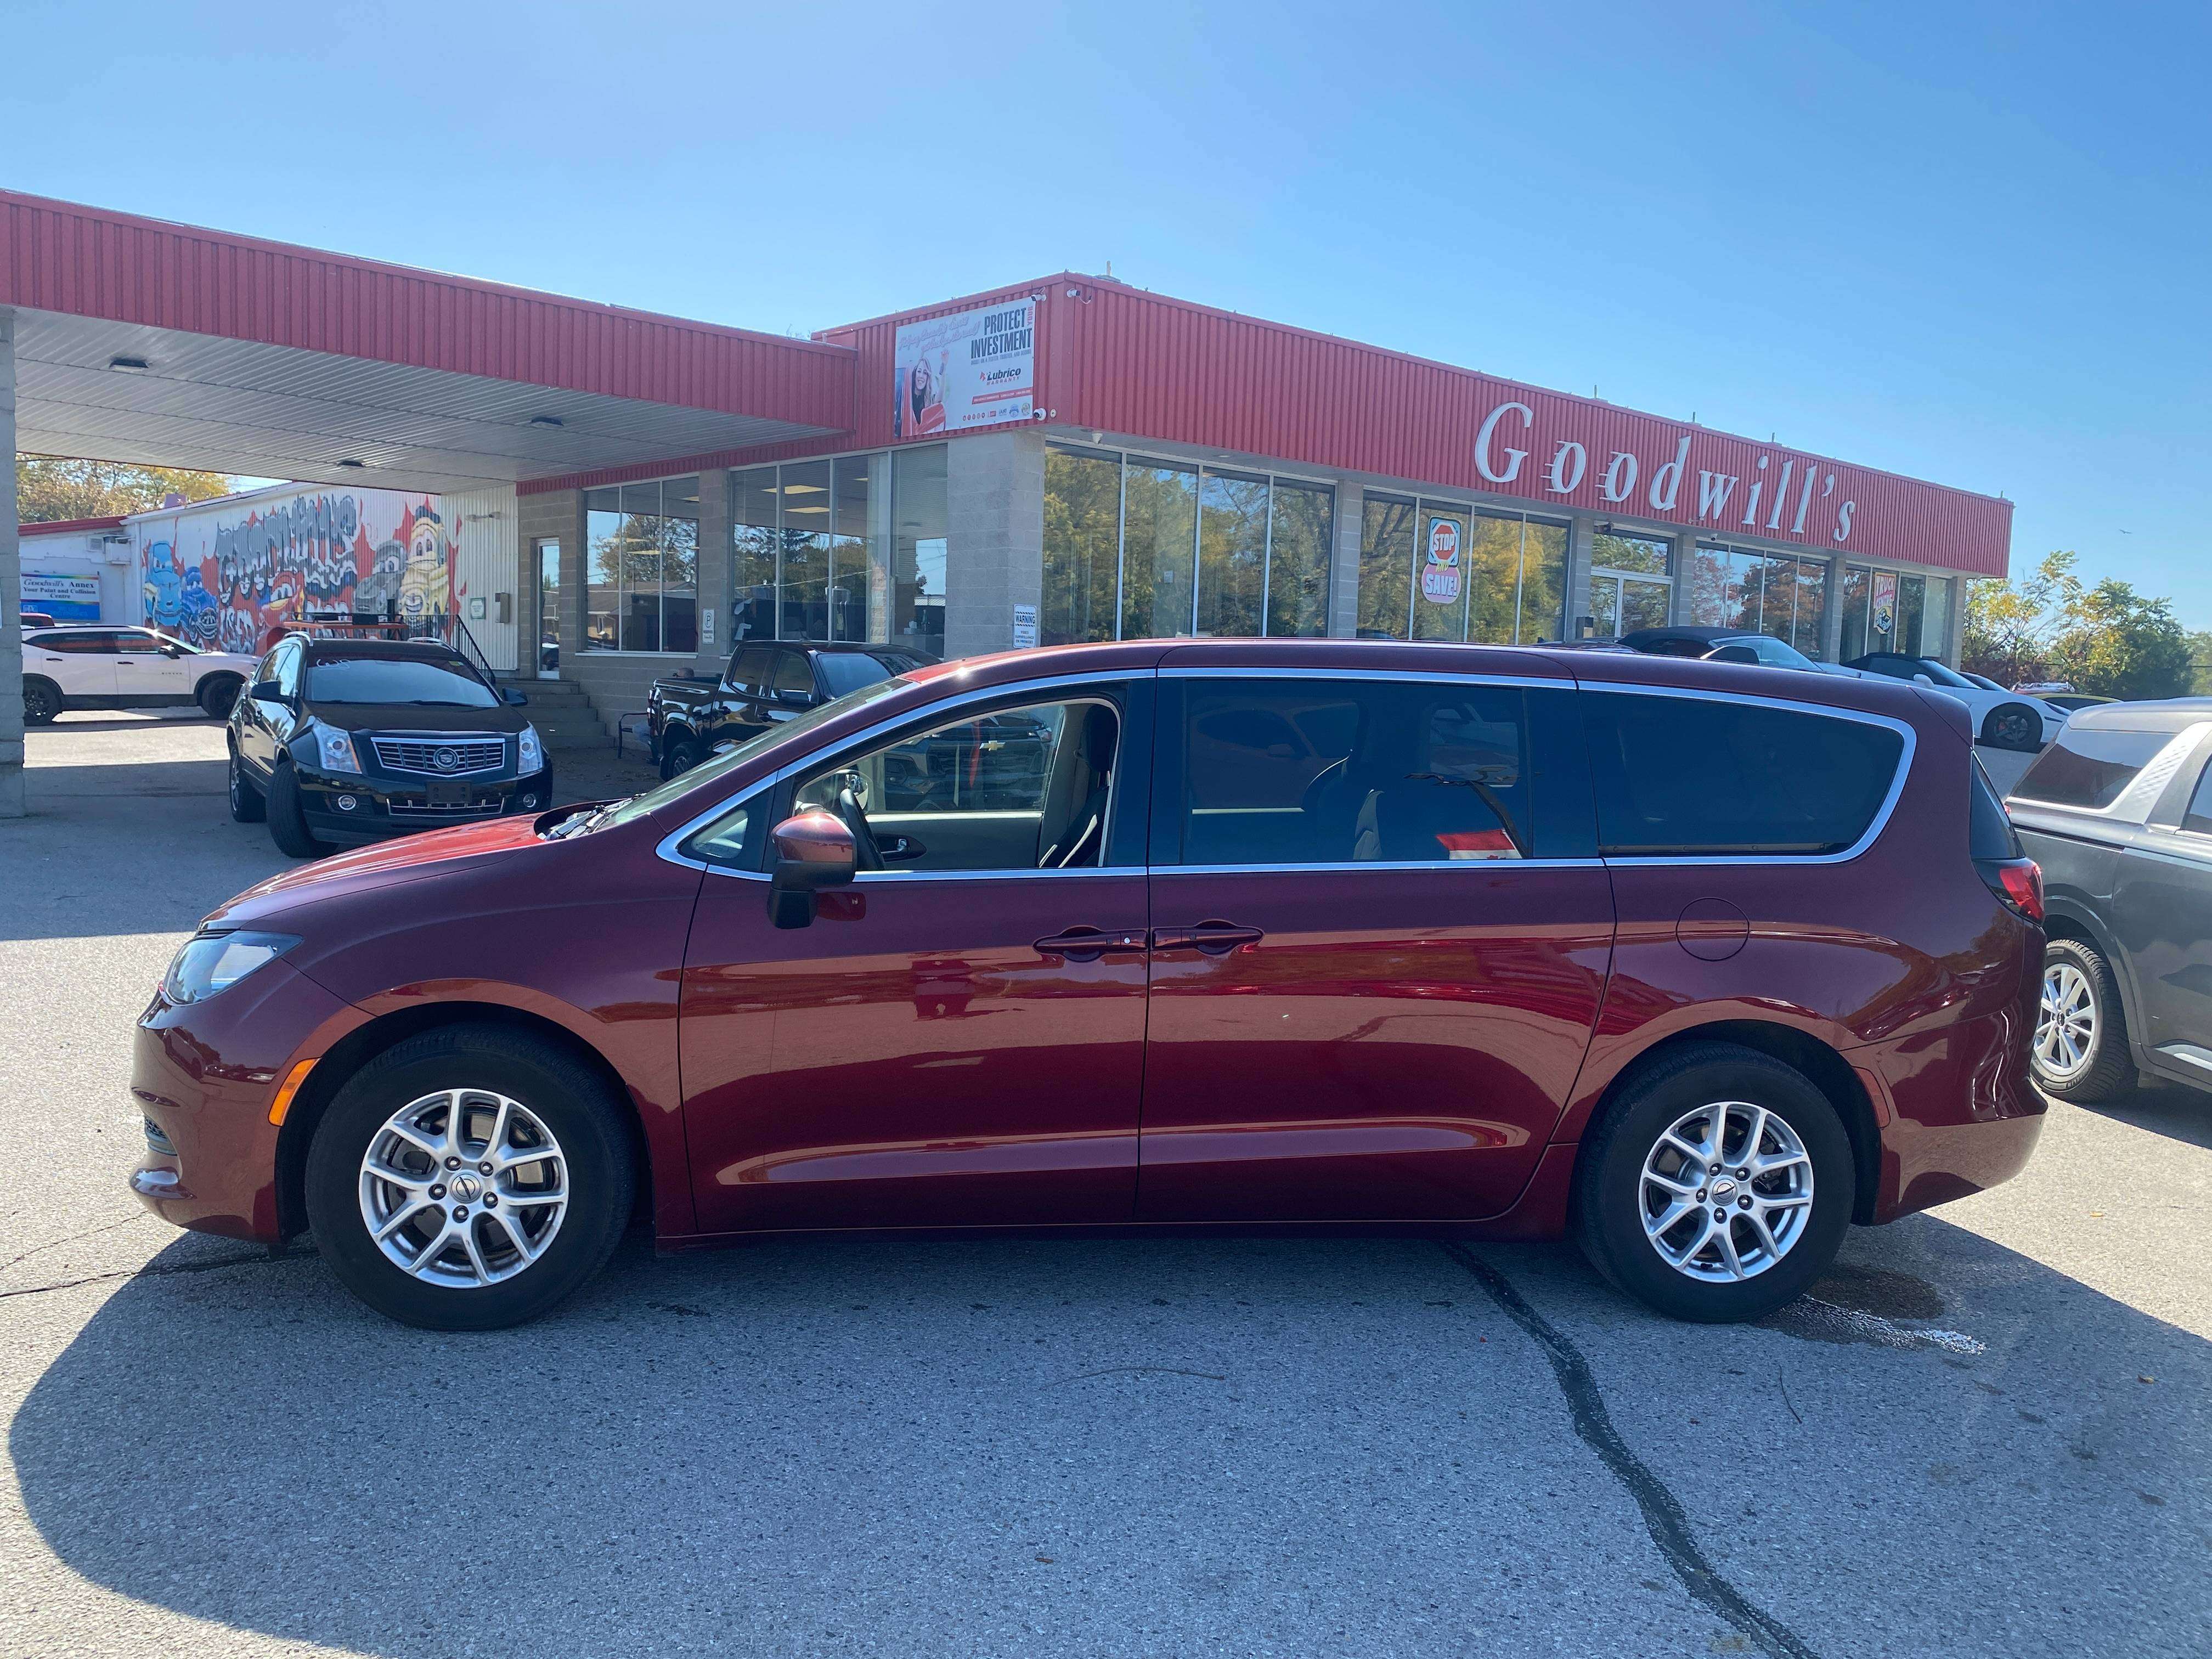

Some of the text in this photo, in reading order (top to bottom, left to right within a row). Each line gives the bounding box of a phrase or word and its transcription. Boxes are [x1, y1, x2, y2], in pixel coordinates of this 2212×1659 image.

[984, 307, 1026, 335] PROTECT
[971, 328, 1032, 359] INVESTMENT
[987, 368, 1021, 381] Lubrico
[987, 376, 1020, 386] WARRANTY
[1474, 402, 1856, 542] Goodwill's
[1434, 533, 1455, 552] STOP
[1435, 562, 1449, 573] AND
[1426, 573, 1458, 597] SAVE!
[1015, 614, 1035, 624] WARNING
